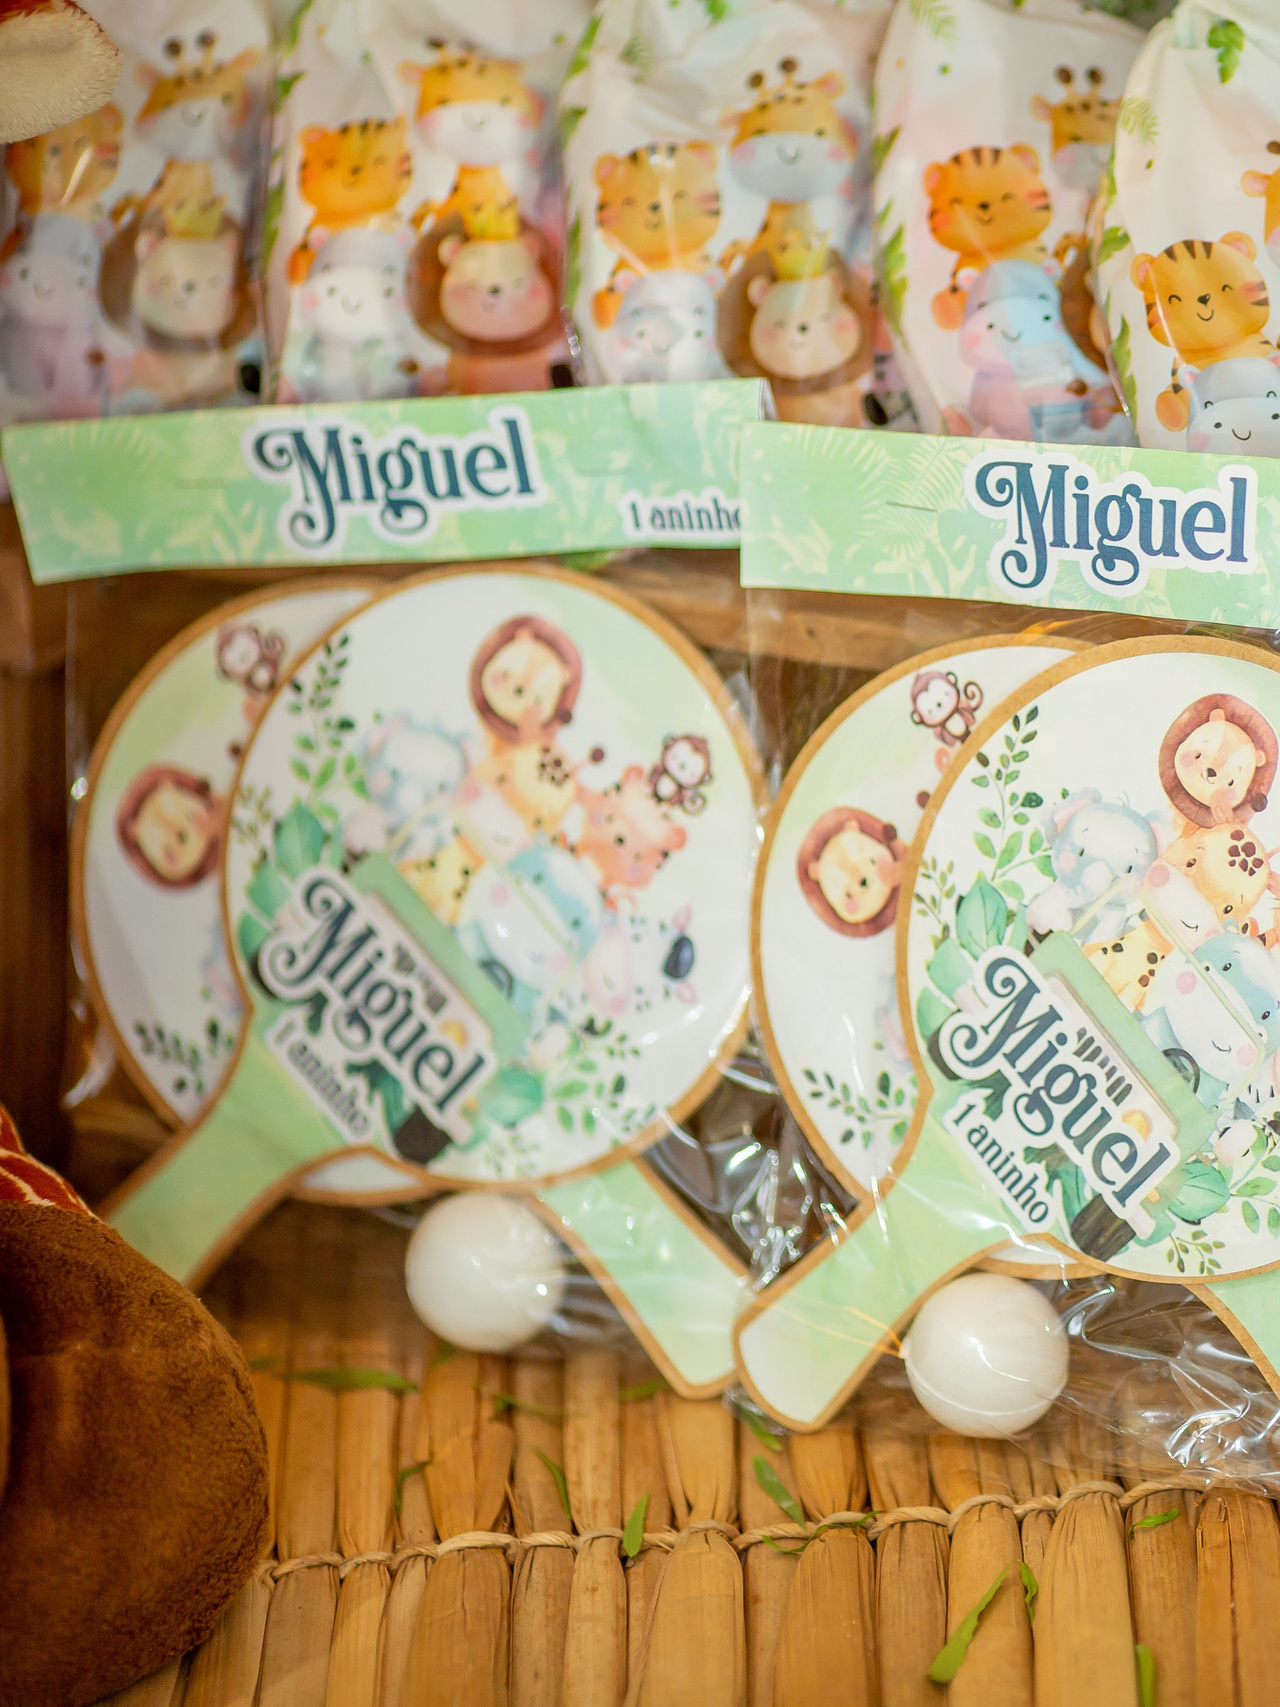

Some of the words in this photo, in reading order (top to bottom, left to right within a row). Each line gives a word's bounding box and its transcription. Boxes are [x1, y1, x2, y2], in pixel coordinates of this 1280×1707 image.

[254, 417, 534, 548] Miguel
[976, 461, 1249, 588] Miguel
[268, 878, 486, 1114] Miguel
[950, 957, 1171, 1208] Miguel
[953, 1103, 976, 1127] 1
[967, 1123, 1050, 1224] aninho
